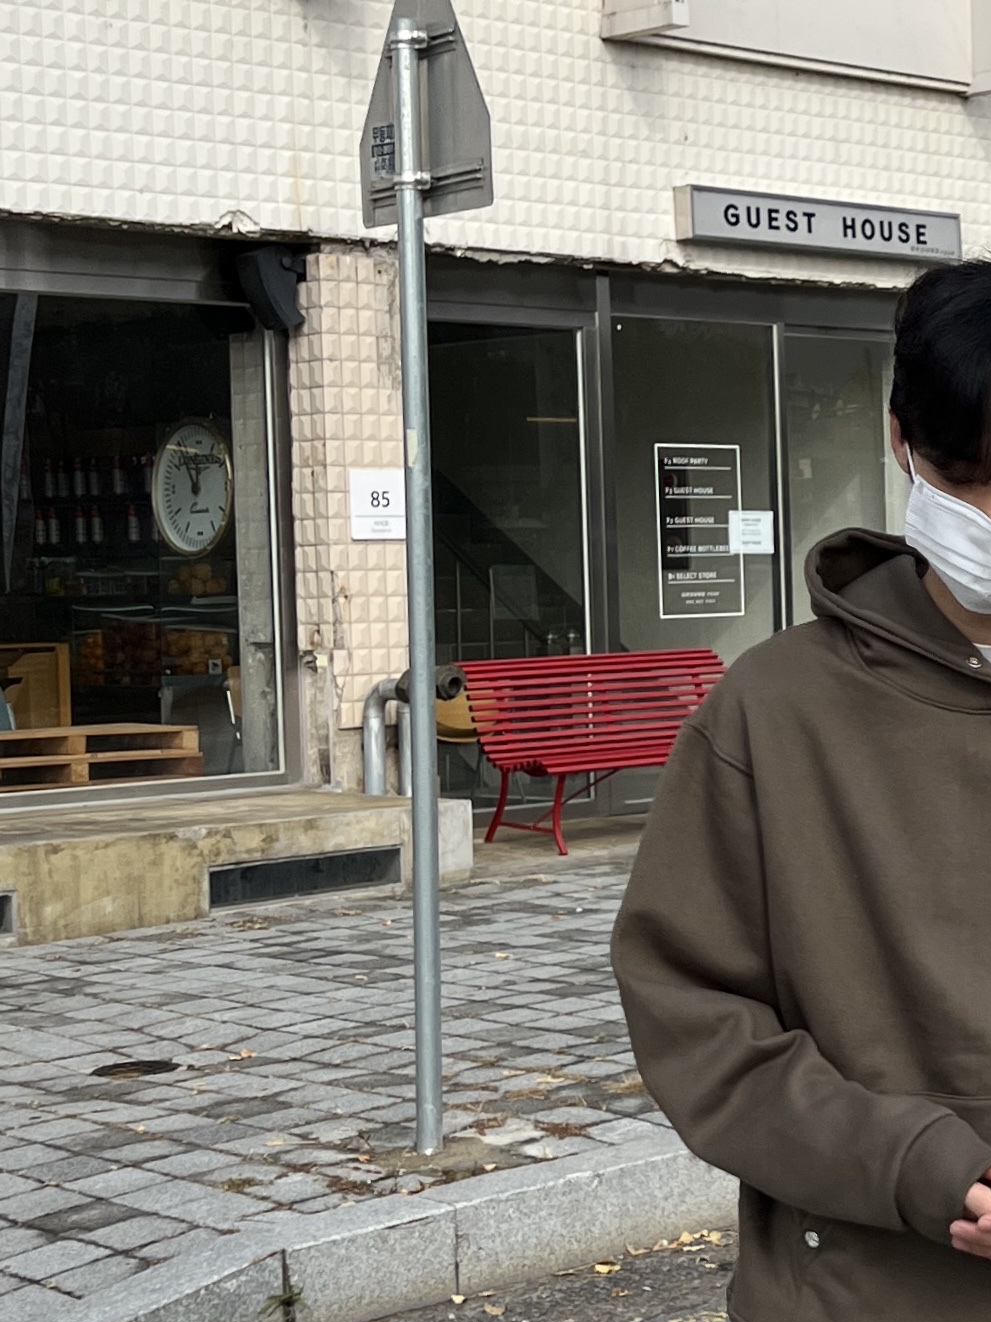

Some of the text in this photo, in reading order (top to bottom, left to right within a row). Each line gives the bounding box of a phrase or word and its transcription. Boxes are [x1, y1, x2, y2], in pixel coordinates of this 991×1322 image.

[723, 203, 928, 245] GUEST HOUSE
[370, 490, 390, 508] 85
